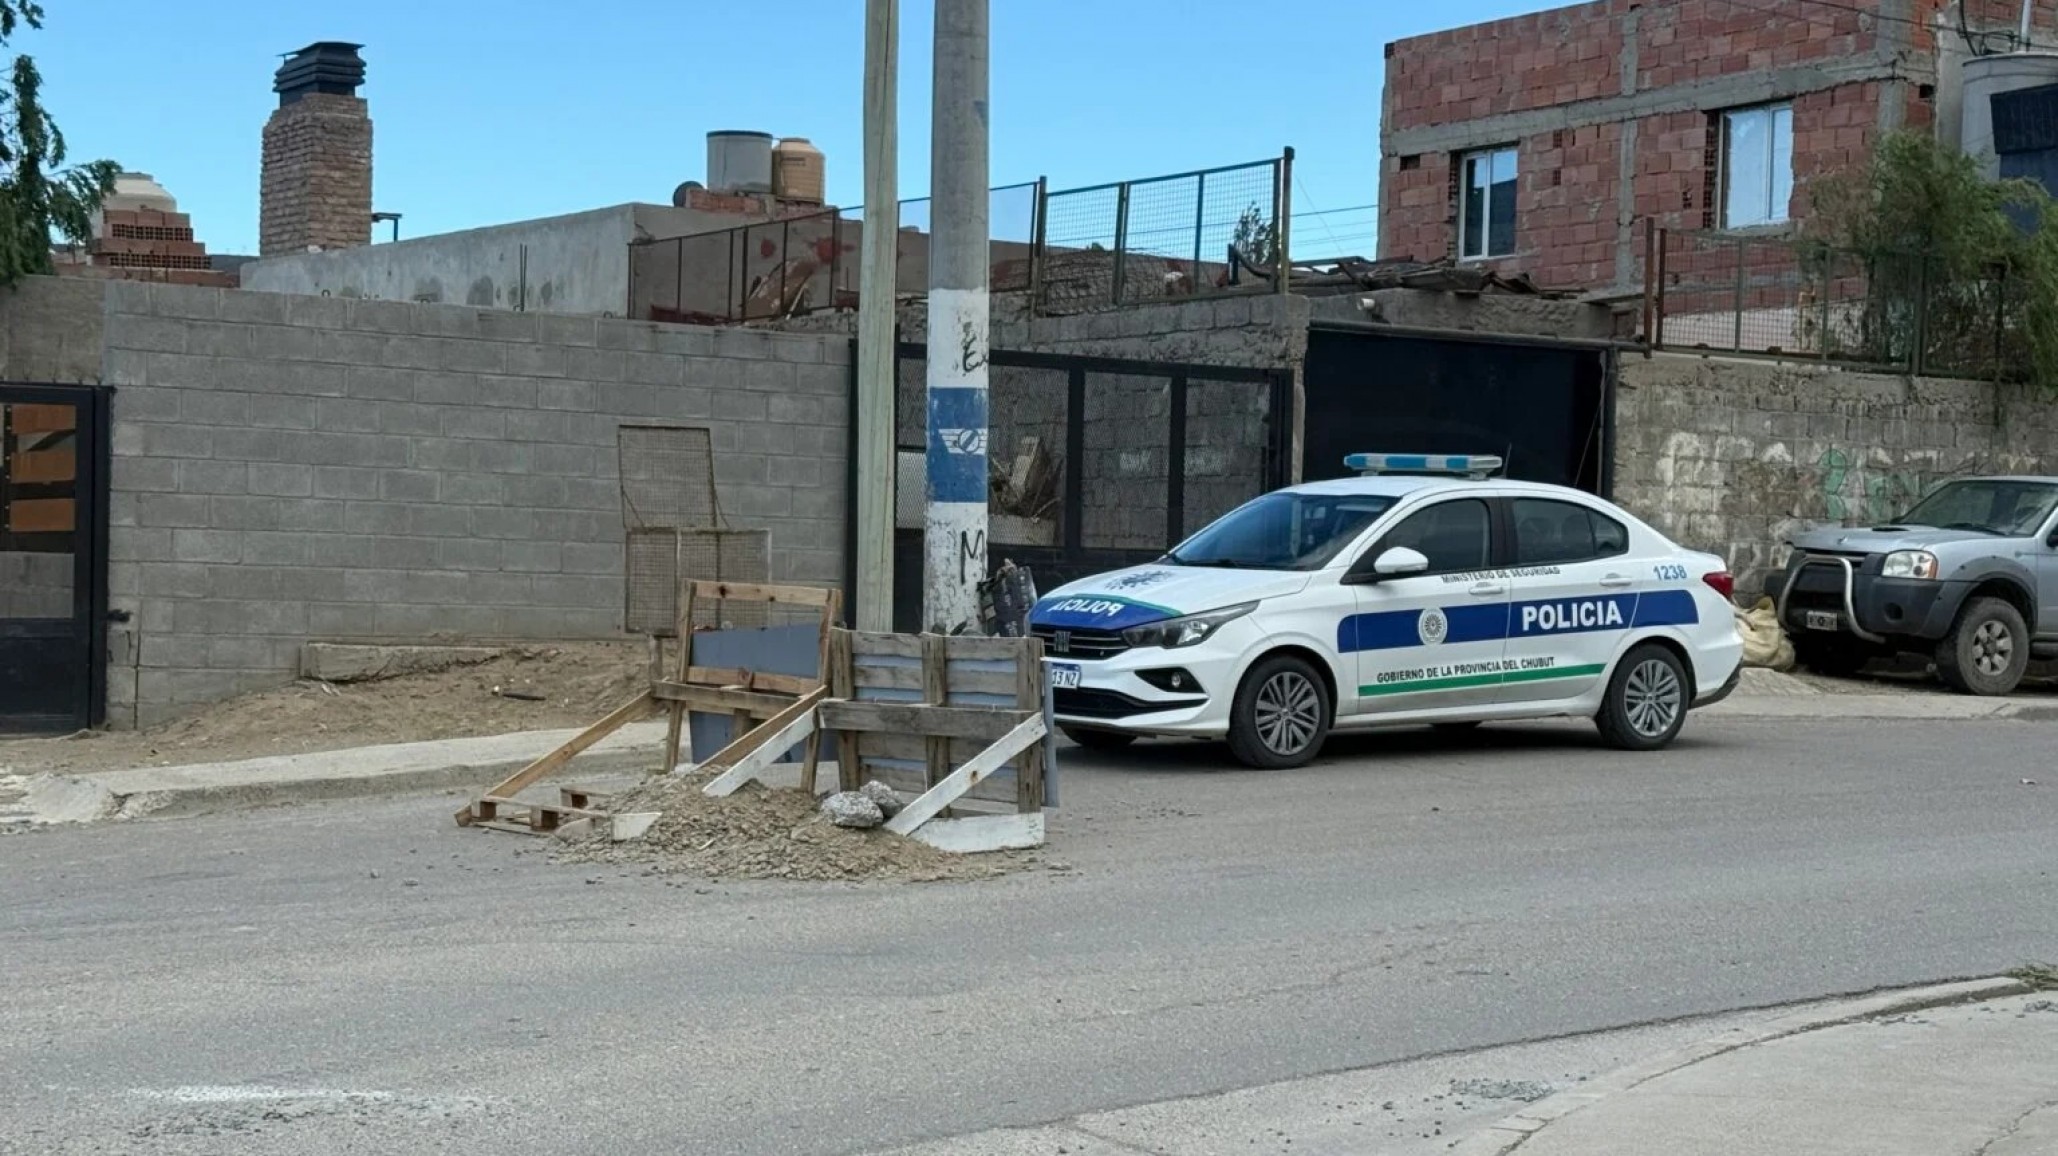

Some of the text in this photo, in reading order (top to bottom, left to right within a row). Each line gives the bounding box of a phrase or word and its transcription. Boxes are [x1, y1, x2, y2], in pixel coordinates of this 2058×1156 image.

[1441, 566, 1560, 583] MINISTERIO DE SEGURIDAD
[1653, 565, 1687, 580] 1238
[1522, 600, 1623, 631] POLICIA
[1377, 656, 1555, 683] GOBIERNO DE LA PROVINCIA DEL CHUBUT
